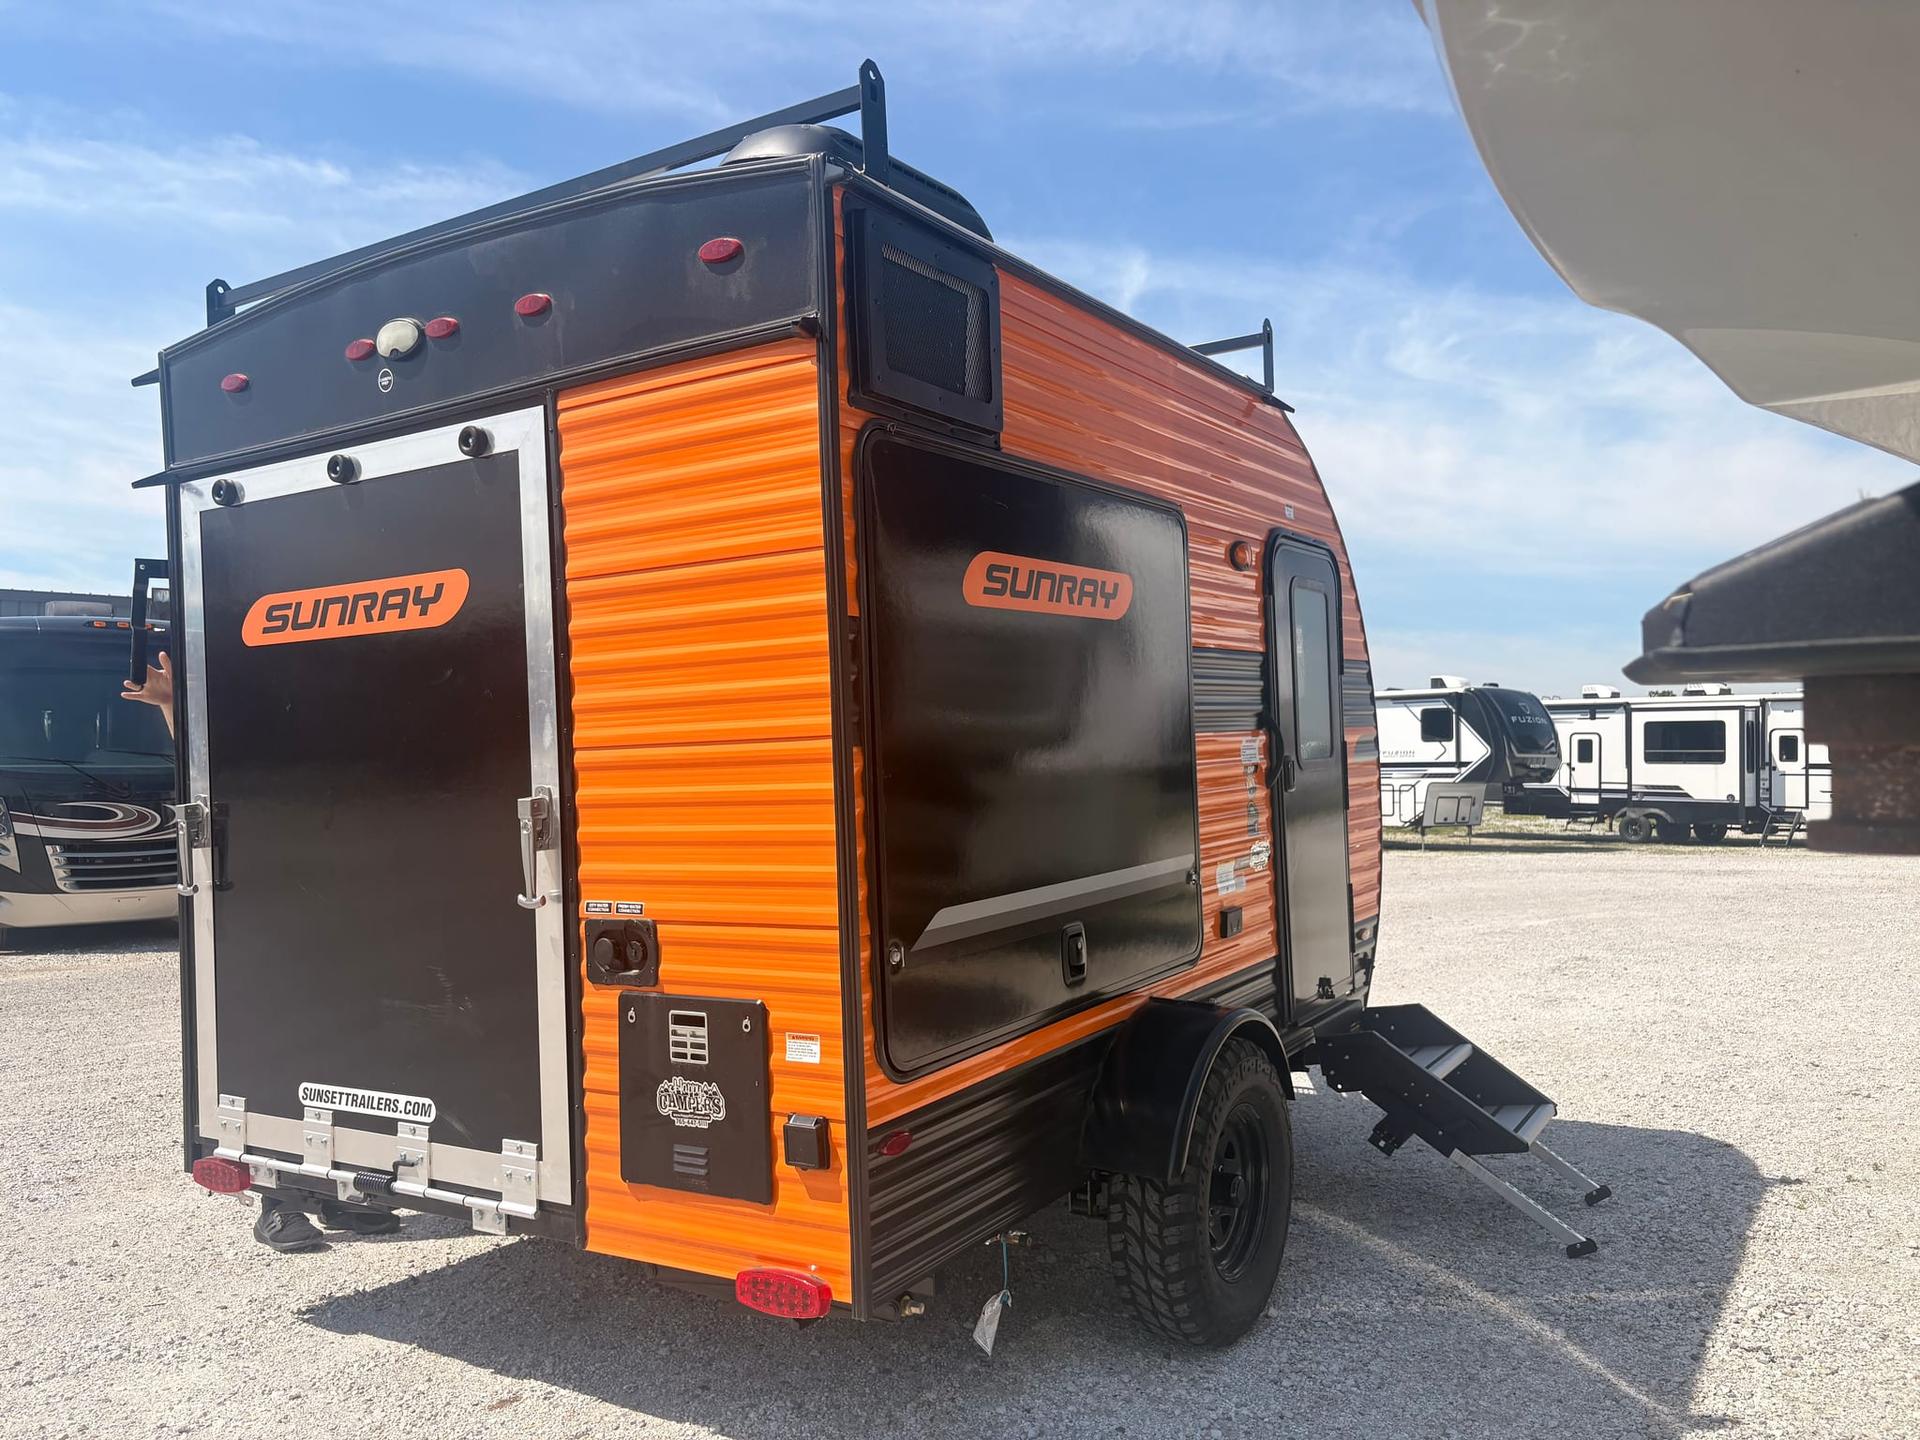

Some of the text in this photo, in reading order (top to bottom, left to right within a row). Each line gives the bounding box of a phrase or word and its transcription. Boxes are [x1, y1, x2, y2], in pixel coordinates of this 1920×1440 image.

[983, 563, 1119, 609] SUNRAY
[262, 582, 444, 634] SUNRAY
[1511, 715, 1547, 725] FUZION
[301, 1087, 433, 1118] SUNSETTRAILERS.COM
[660, 1094, 722, 1114] CAMPERS
